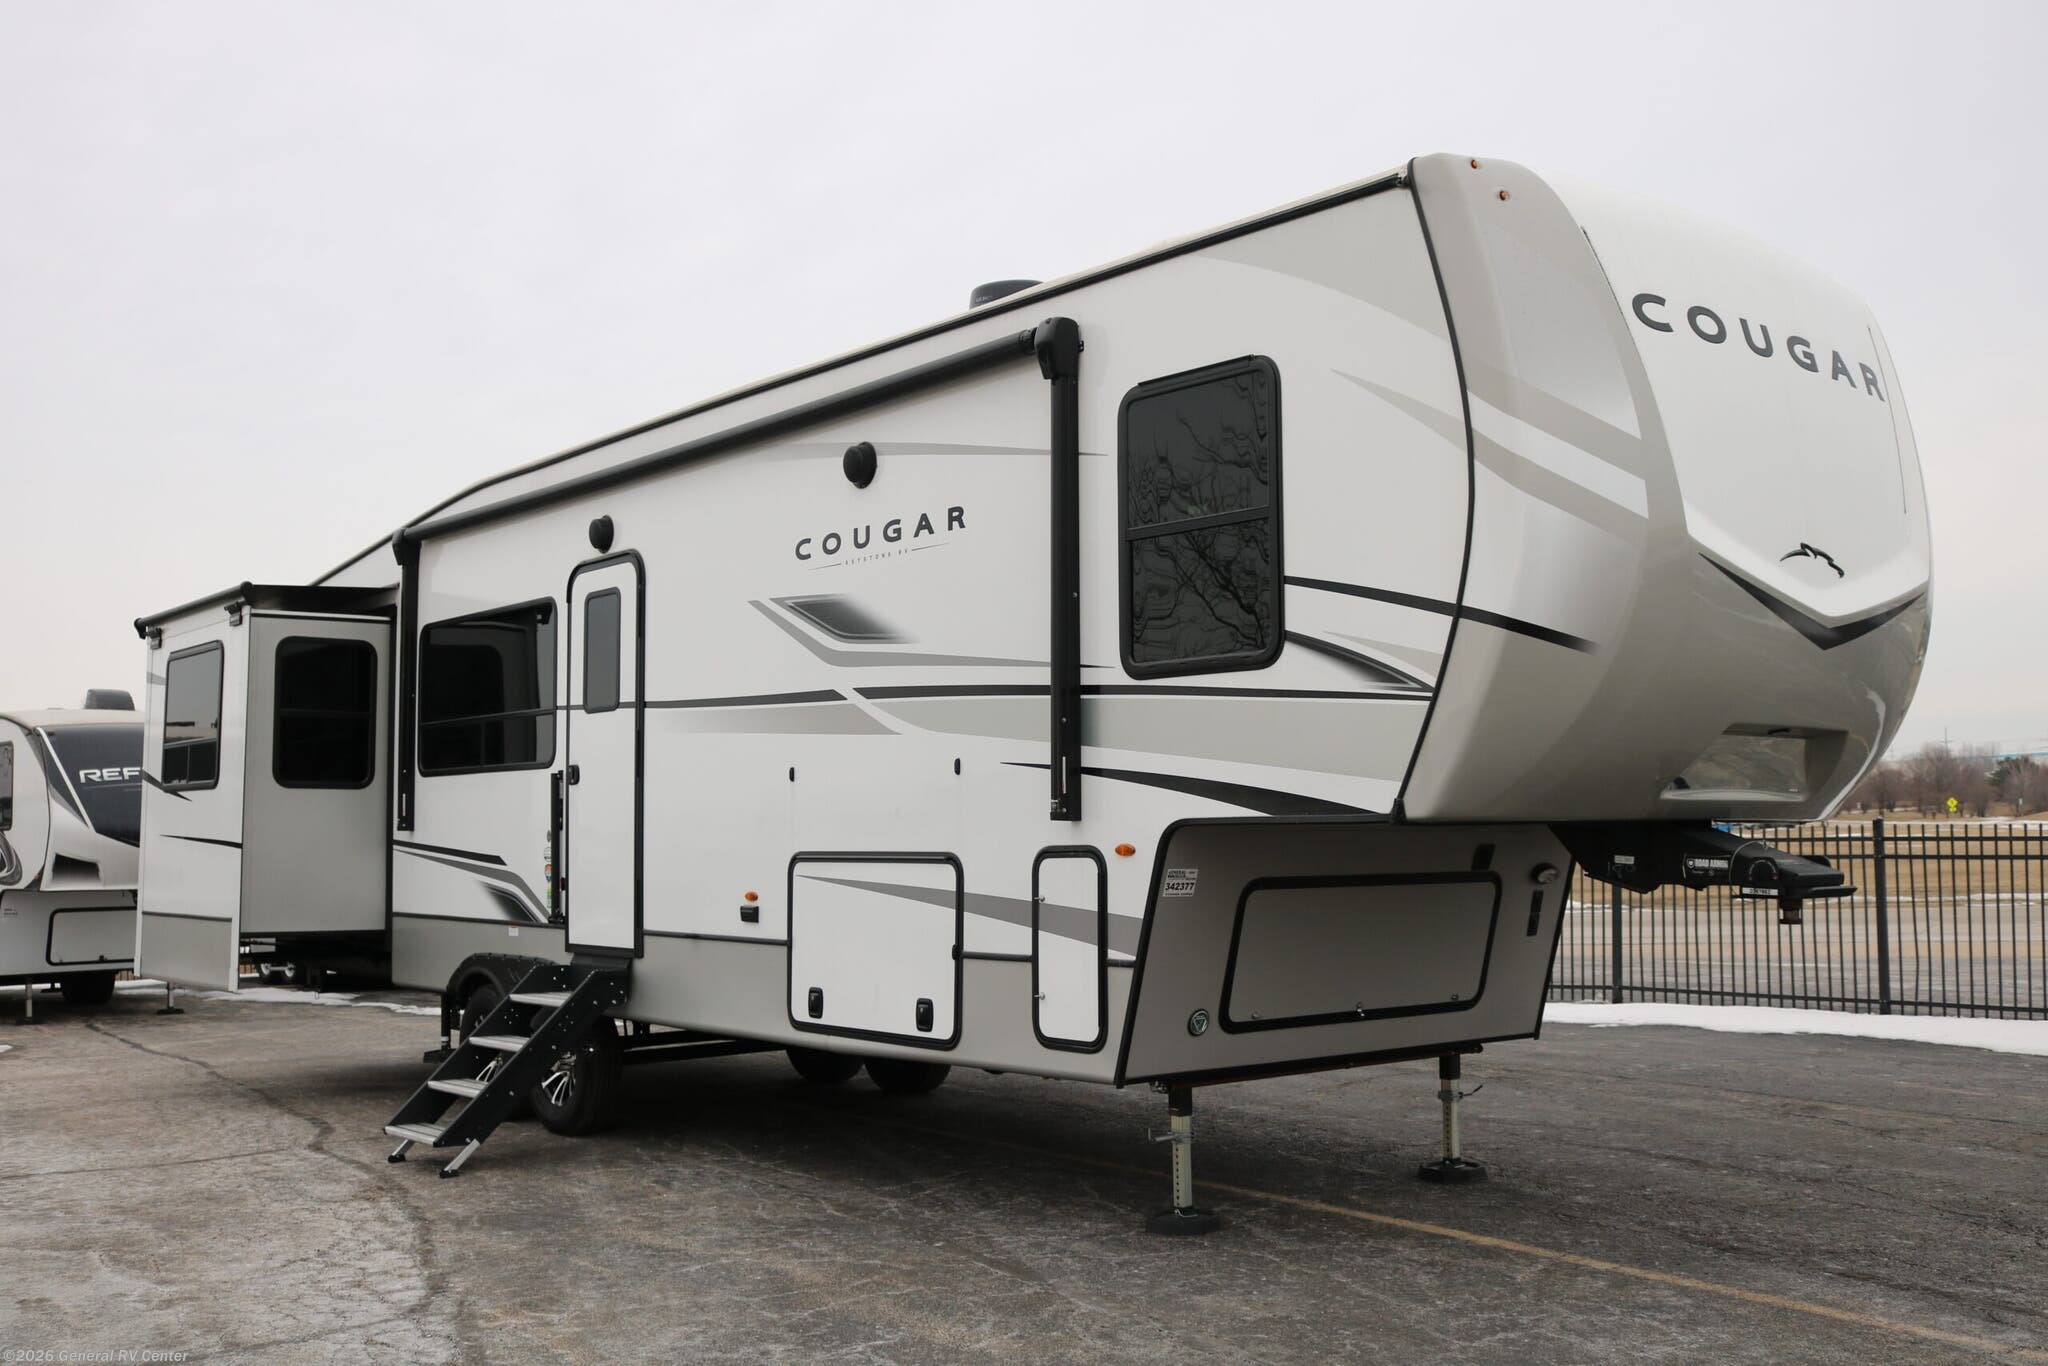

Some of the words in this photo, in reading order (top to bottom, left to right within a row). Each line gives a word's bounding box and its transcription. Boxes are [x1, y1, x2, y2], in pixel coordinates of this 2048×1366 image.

[1632, 293, 1885, 402] COUGAR
[795, 506, 966, 560] COUGAR
[1165, 882, 1194, 890] 342377
